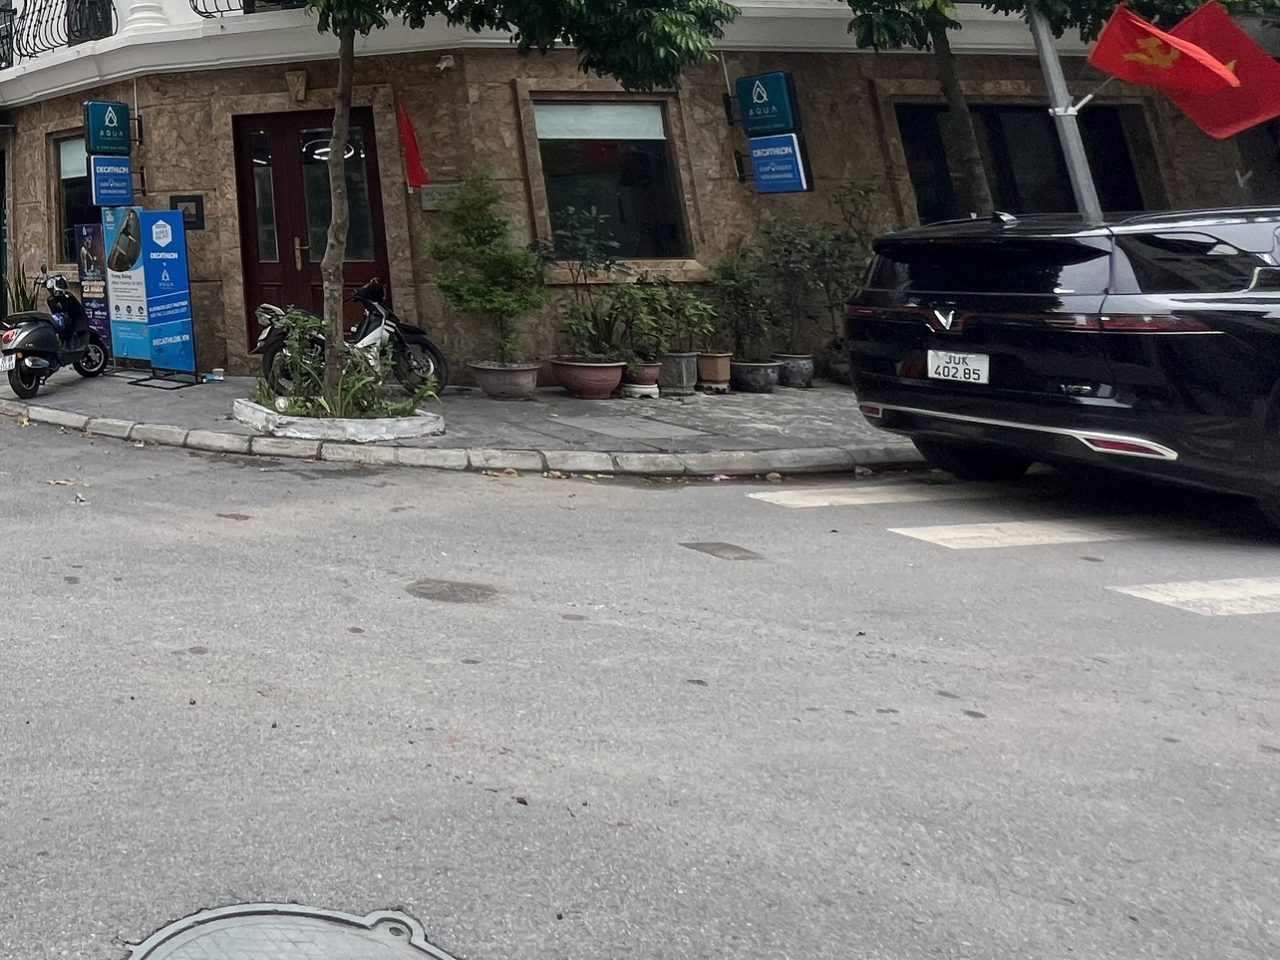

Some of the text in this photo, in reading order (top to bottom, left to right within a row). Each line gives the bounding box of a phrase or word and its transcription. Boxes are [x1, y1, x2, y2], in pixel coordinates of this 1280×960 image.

[748, 106, 778, 116] AQUA
[100, 129, 124, 137] AQUA
[752, 146, 793, 158] DECATHLON
[934, 365, 981, 381] 402.85
